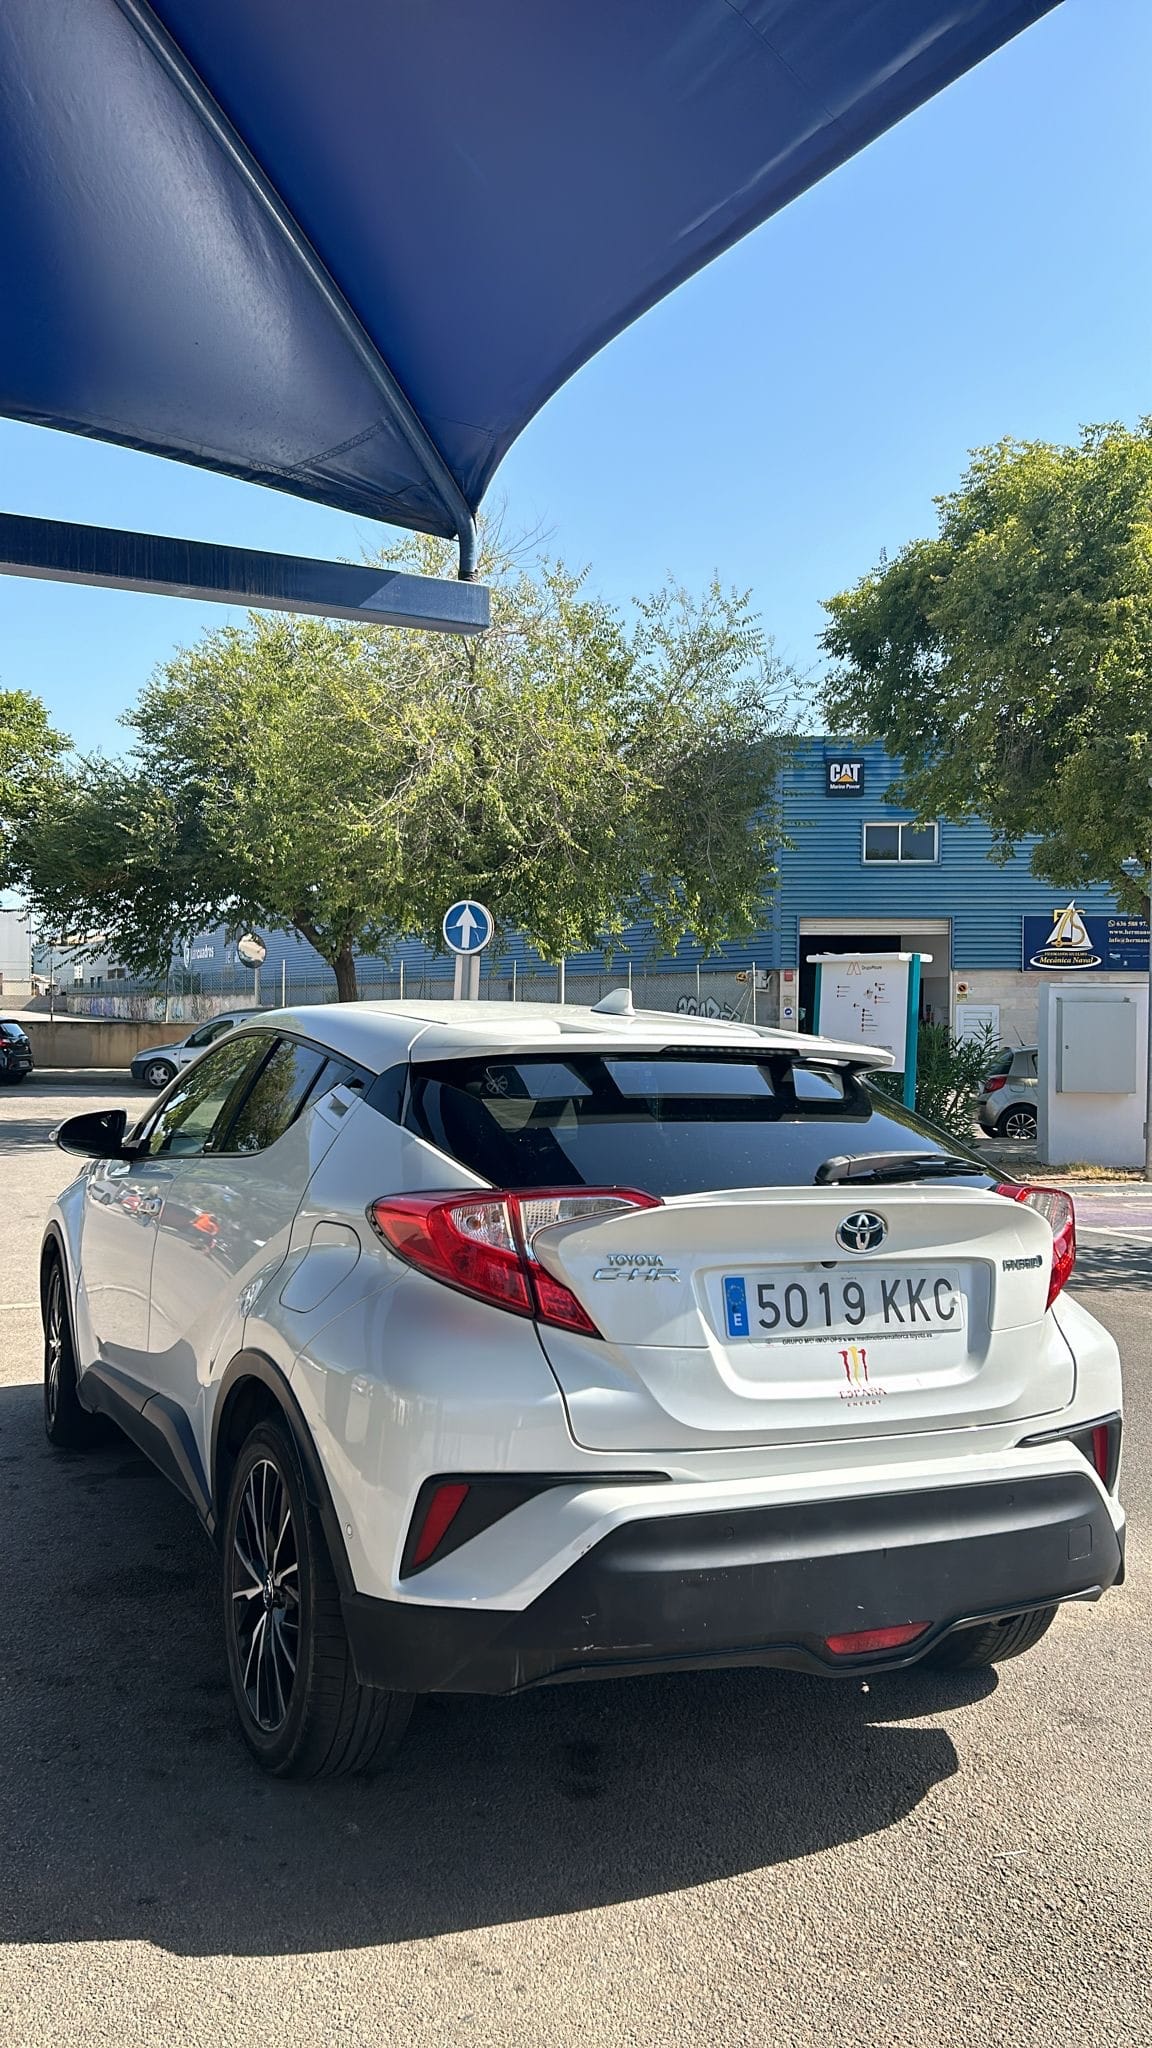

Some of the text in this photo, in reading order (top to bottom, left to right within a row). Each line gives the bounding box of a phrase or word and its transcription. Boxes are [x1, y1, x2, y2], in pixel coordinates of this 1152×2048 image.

[830, 763, 861, 782] CAT
[1072, 956, 1094, 964] Naval
[607, 1253, 664, 1267] TOYOTA
[592, 1267, 681, 1282] C-HR
[757, 1278, 953, 1329] 5019 KKC
[734, 1313, 742, 1327] E
[839, 1387, 888, 1400] ESPAÑA
